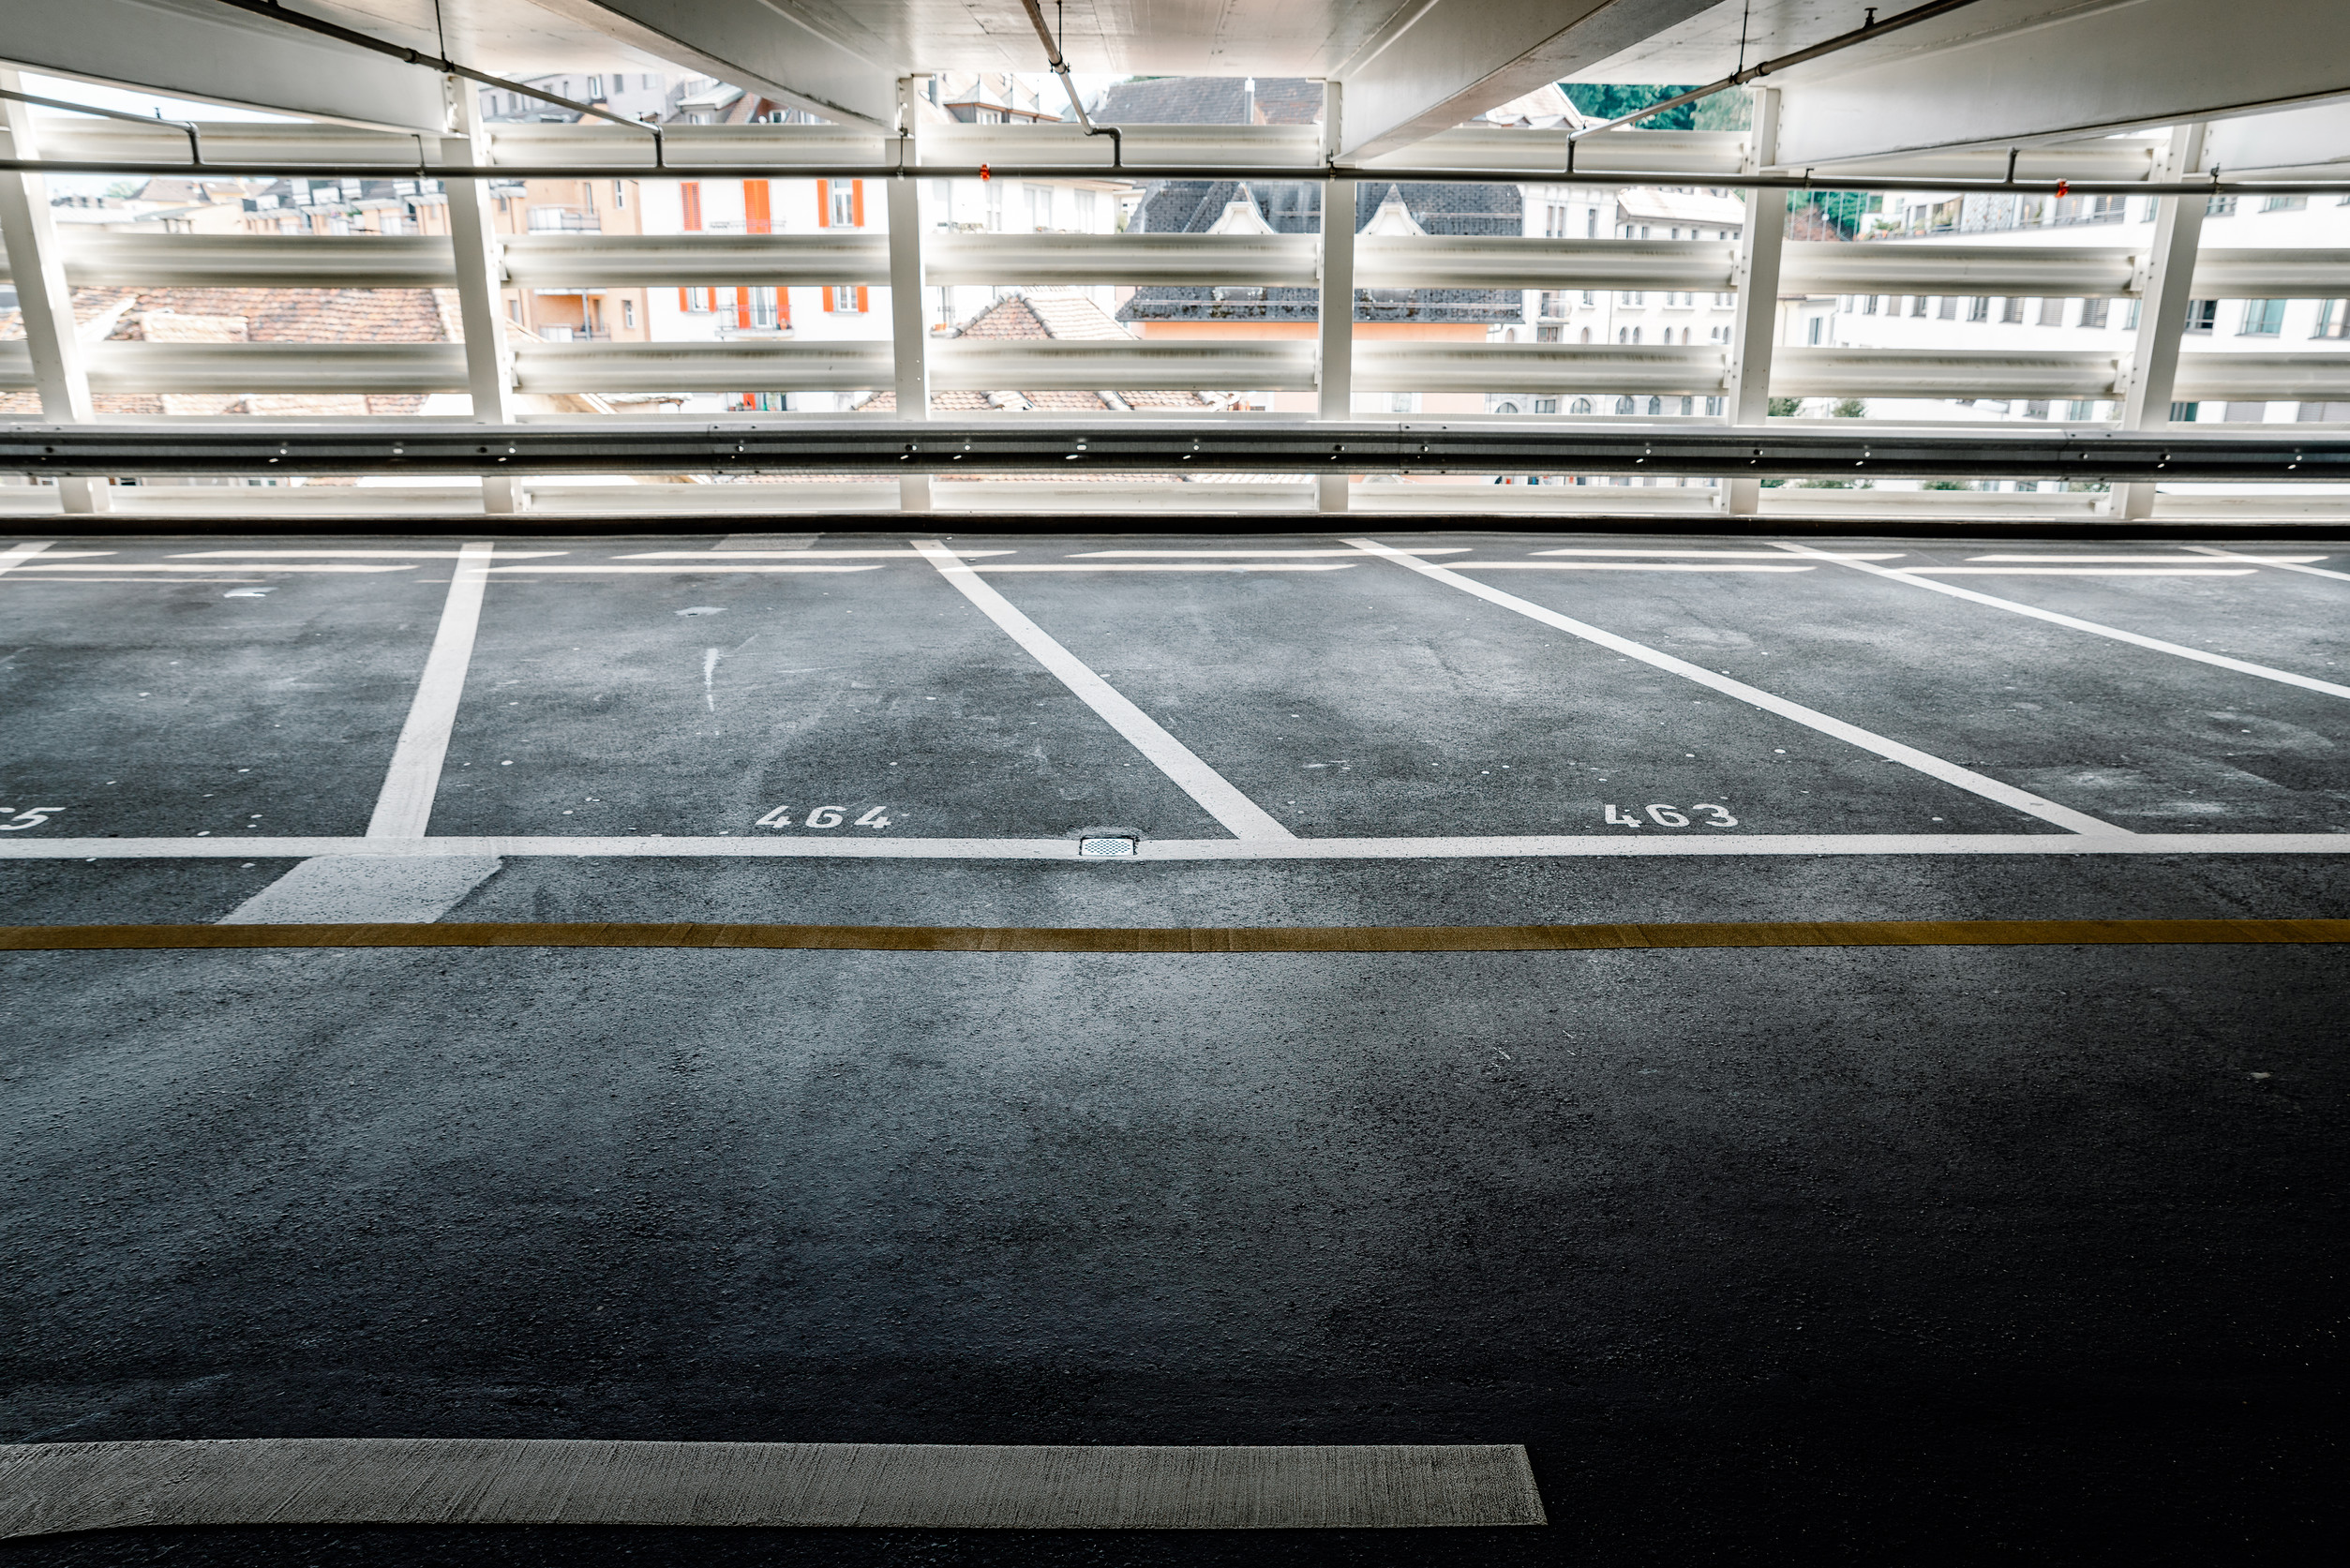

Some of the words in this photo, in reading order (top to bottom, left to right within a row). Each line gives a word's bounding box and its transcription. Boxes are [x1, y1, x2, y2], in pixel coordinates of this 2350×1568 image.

[0, 807, 67, 830] 5
[754, 805, 893, 829] 464
[1605, 803, 1739, 828] 463
